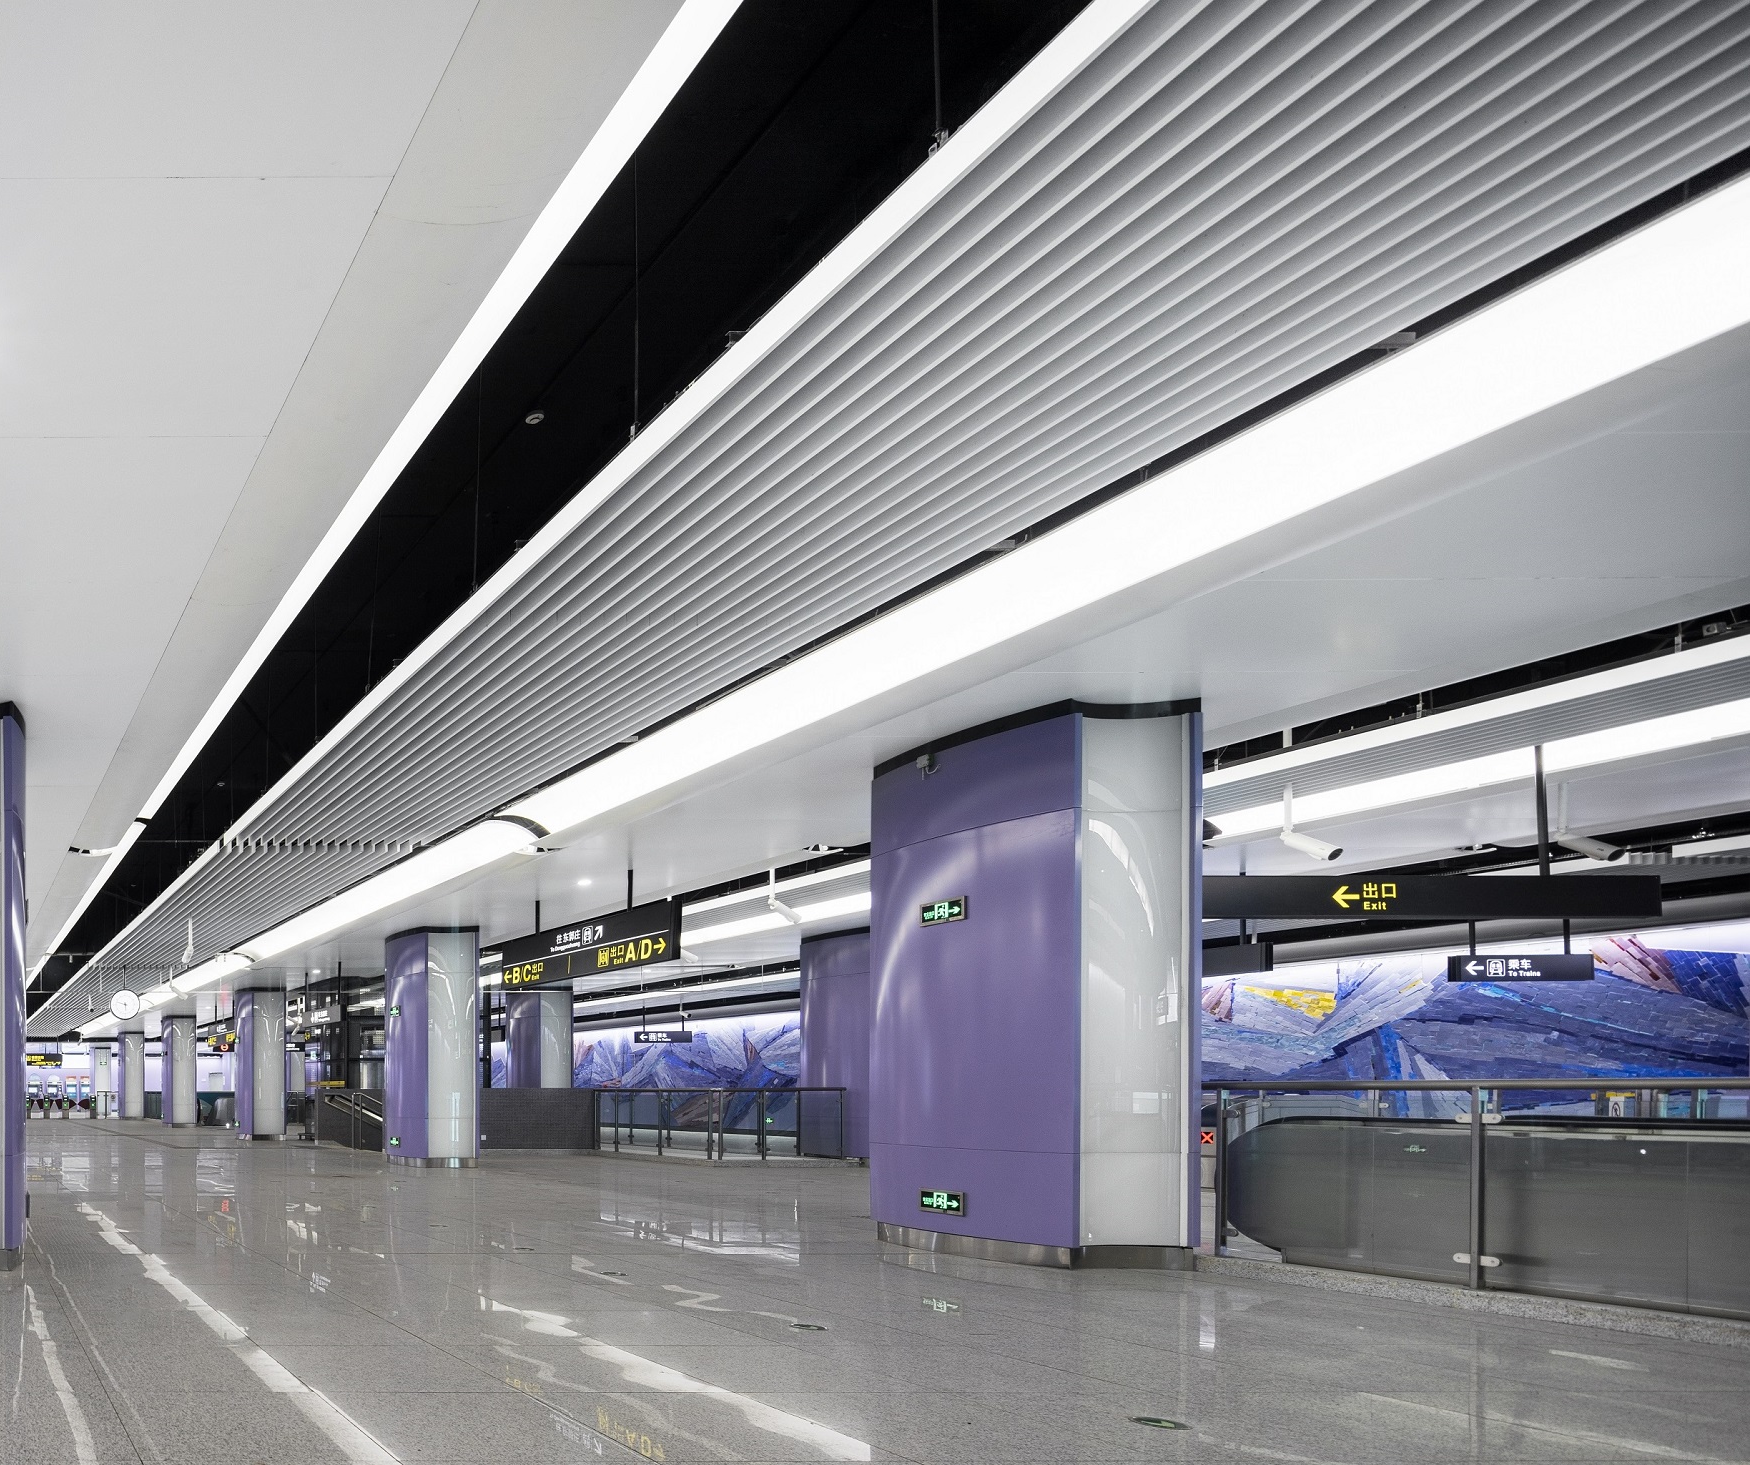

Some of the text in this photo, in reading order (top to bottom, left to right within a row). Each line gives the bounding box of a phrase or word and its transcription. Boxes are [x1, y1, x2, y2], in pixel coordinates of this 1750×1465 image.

[1363, 882, 1397, 899] 出口
[1363, 901, 1387, 910] Exit
[610, 944, 625, 958] 出口
[625, 938, 652, 963] A/D
[531, 962, 544, 974] 出口
[1507, 958, 1532, 970] 乘车
[512, 964, 532, 984] B/C
